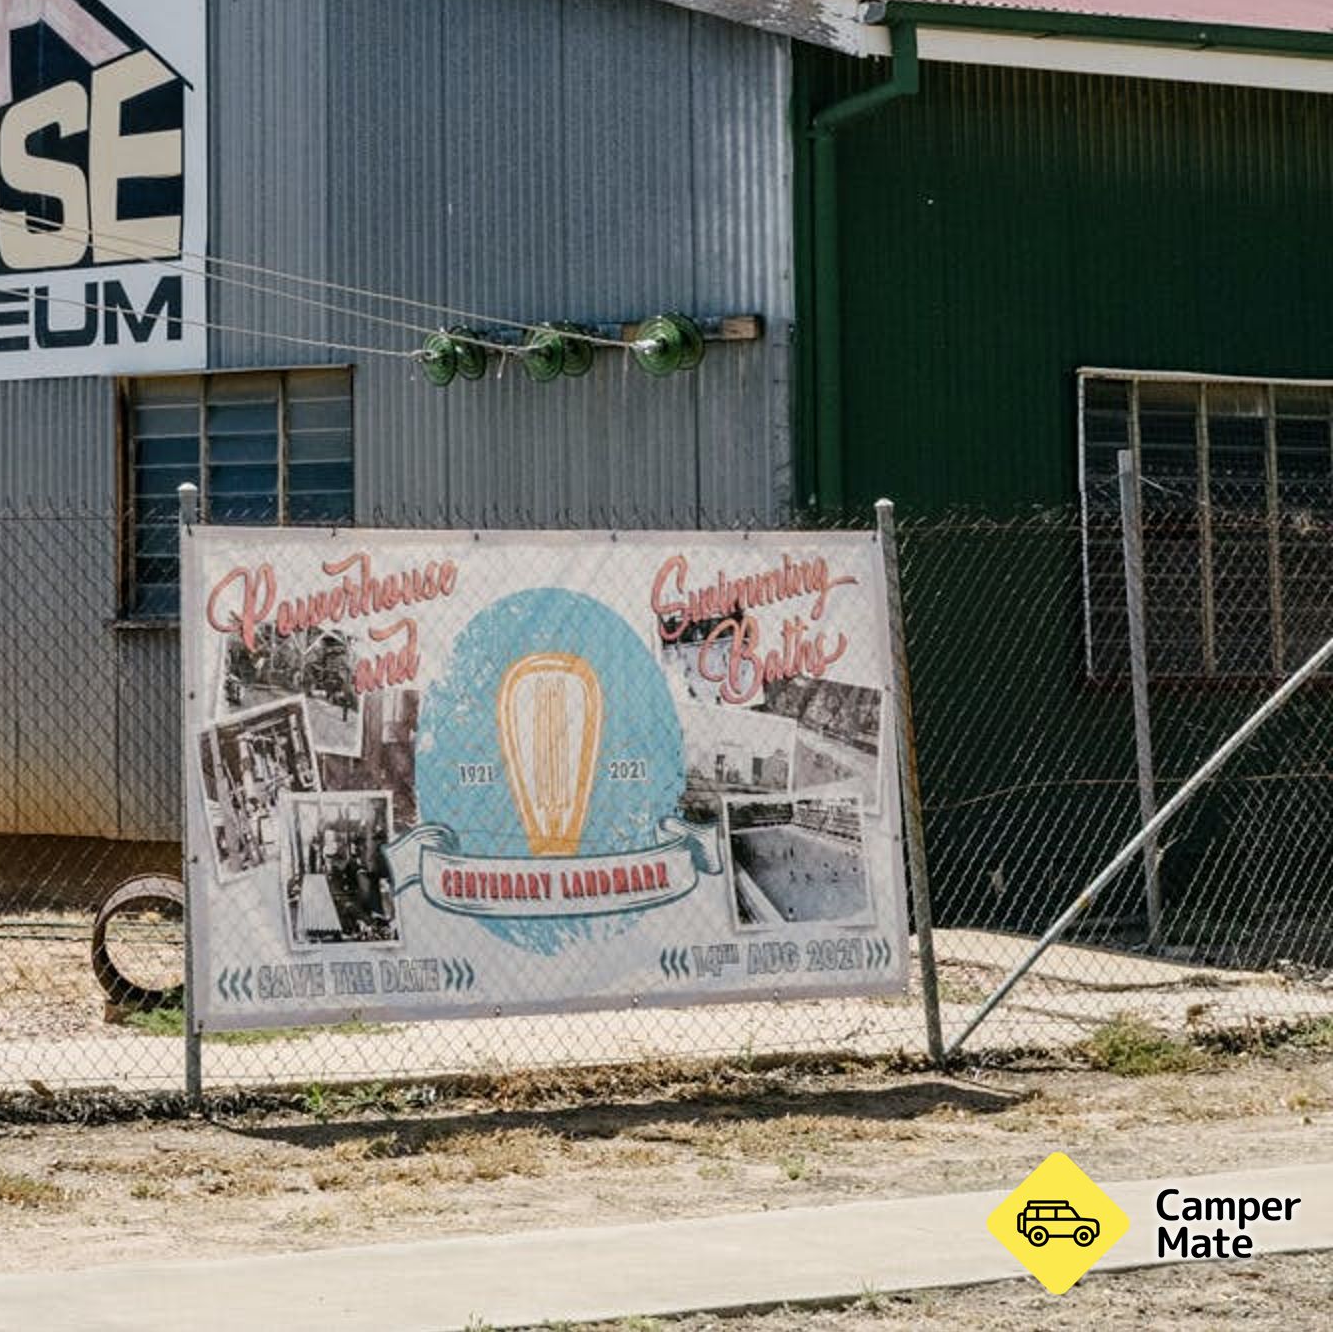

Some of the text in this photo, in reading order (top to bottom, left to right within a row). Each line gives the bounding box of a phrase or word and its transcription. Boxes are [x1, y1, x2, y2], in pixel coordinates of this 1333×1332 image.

[207, 552, 459, 653] Powerhouse
[651, 553, 859, 641] Swimming
[354, 617, 421, 695] and
[698, 614, 848, 705] Baths
[460, 764, 495, 784] 1921
[609, 761, 647, 781] 2021
[440, 861, 671, 900] CENTENARY LANDMARK
[747, 941, 801, 975] AUG
[806, 937, 863, 972] 2021
[257, 959, 440, 999] SAVE THE DATE
